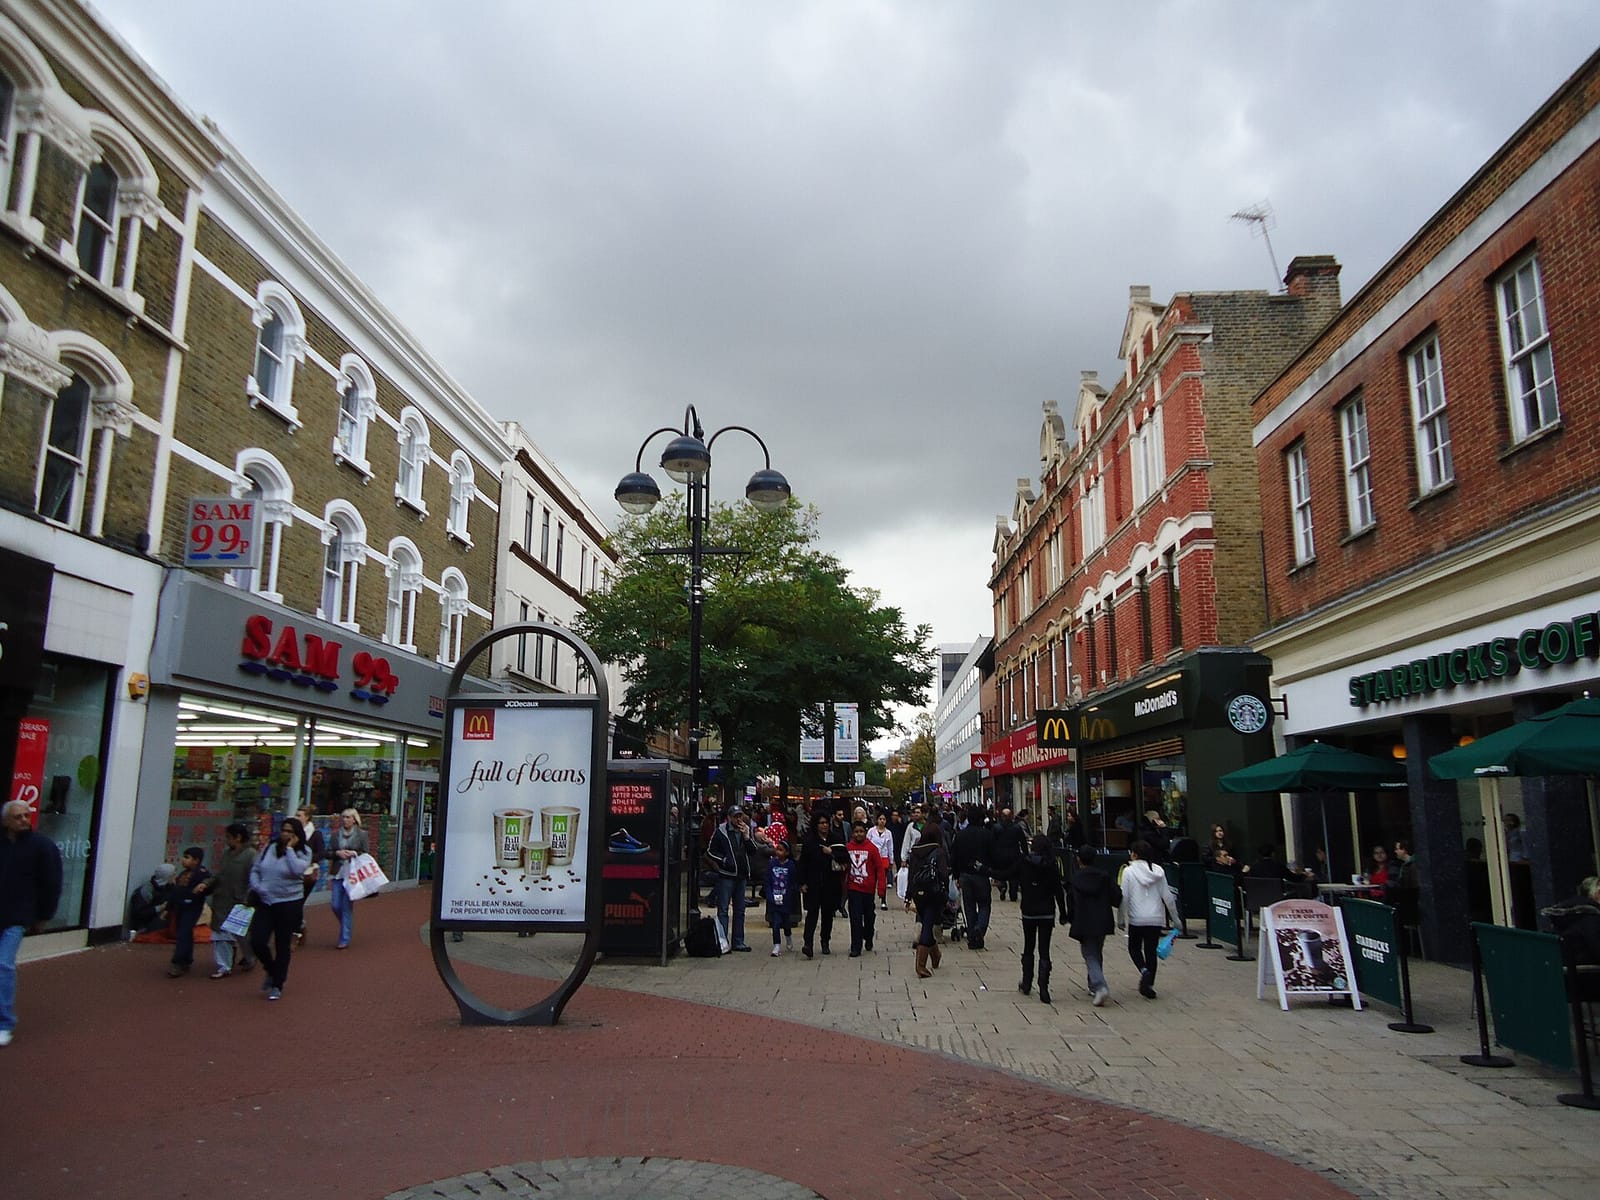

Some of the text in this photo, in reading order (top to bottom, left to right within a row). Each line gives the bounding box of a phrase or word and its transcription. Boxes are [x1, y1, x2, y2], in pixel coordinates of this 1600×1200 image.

[193, 503, 252, 520] SAM
[242, 615, 343, 680] SAM
[1350, 611, 1600, 708] STARBUCKS COF
[504, 700, 539, 708] JCDecaux
[1134, 690, 1178, 717] McDonald's
[456, 753, 586, 794] full of beans
[612, 798, 637, 806] ATHLETE
[349, 862, 379, 885] SALE
[1355, 934, 1390, 954] STARBUCKS
[1361, 947, 1385, 964] COFFEE
